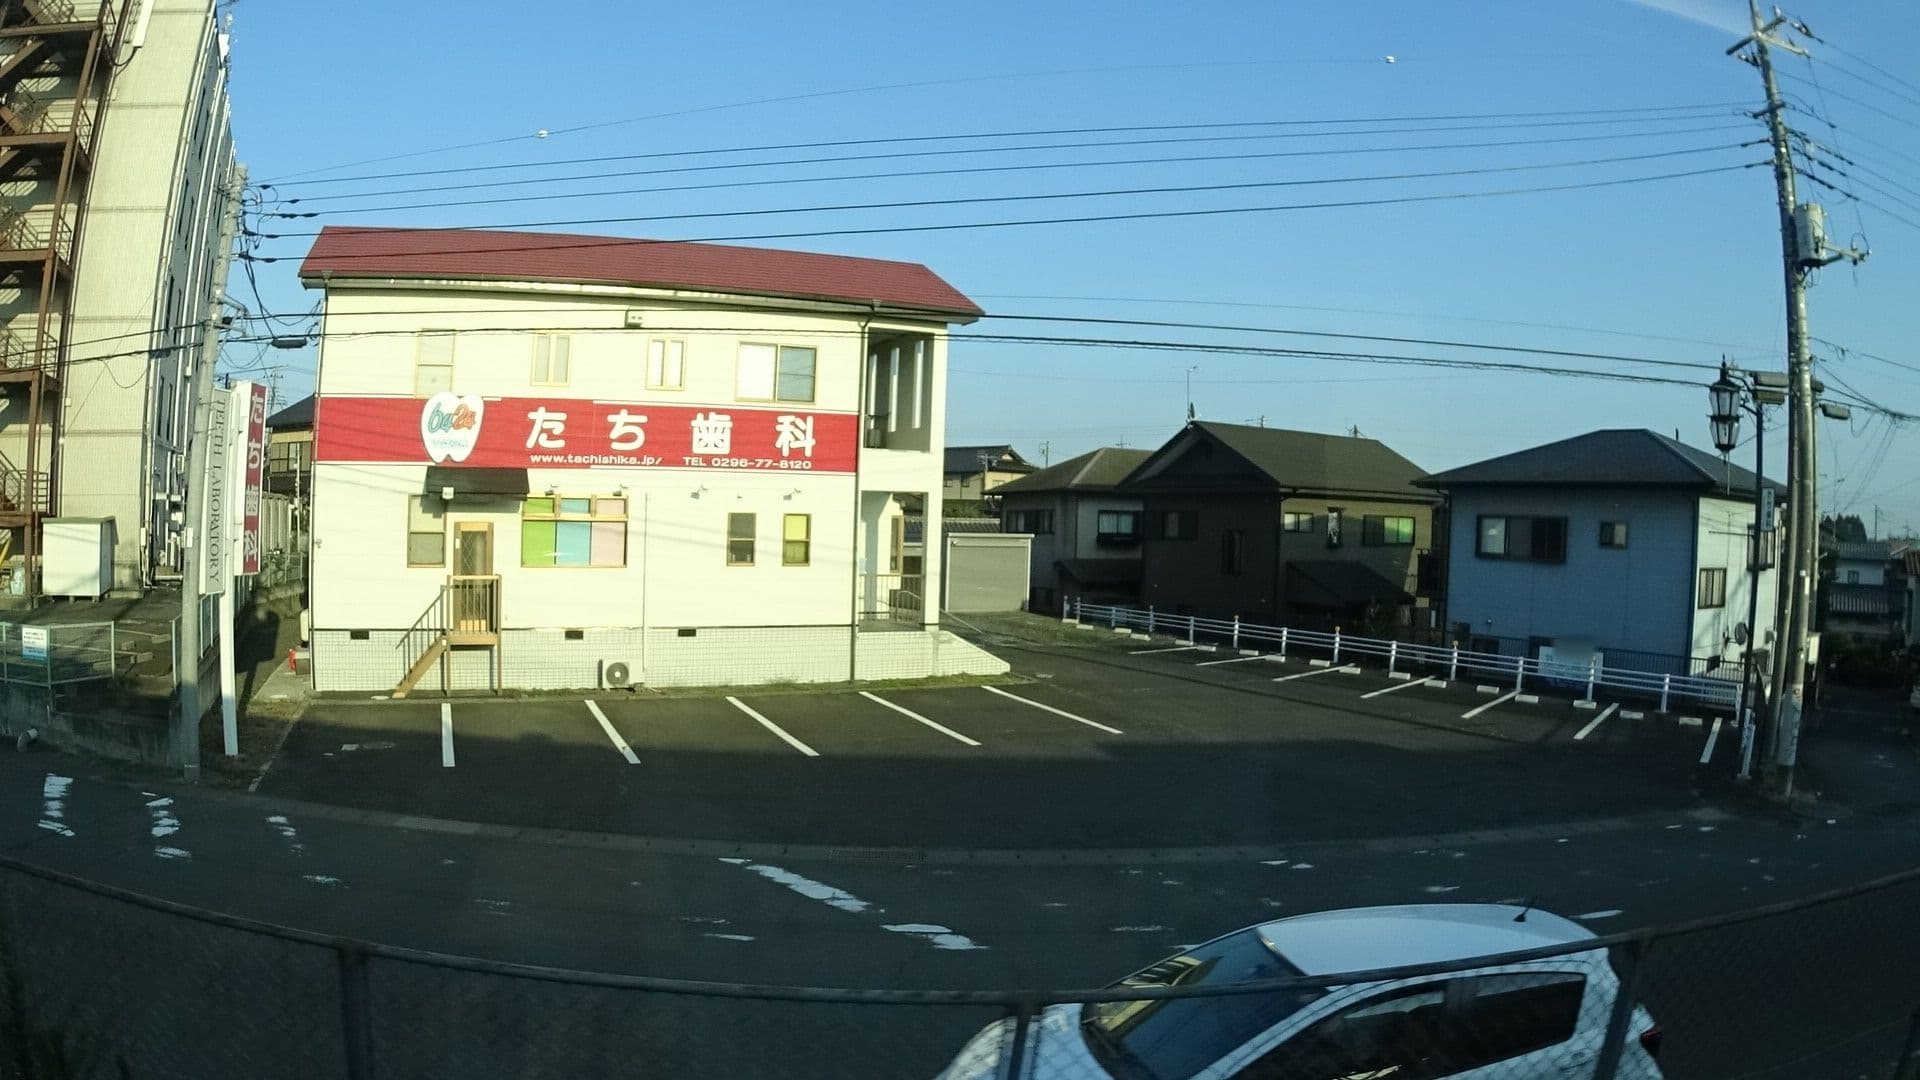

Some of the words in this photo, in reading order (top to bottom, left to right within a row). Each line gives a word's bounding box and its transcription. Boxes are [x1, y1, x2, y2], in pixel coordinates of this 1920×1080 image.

[213, 398, 226, 456] TEETH
[526, 406, 816, 457] たち歯科
[244, 393, 263, 562] たち歯科
[530, 453, 663, 466] www.tachishika.jp/
[683, 457, 706, 467] TEL
[711, 458, 812, 470] 0296-77-8120
[209, 465, 222, 583] LABORATORY
